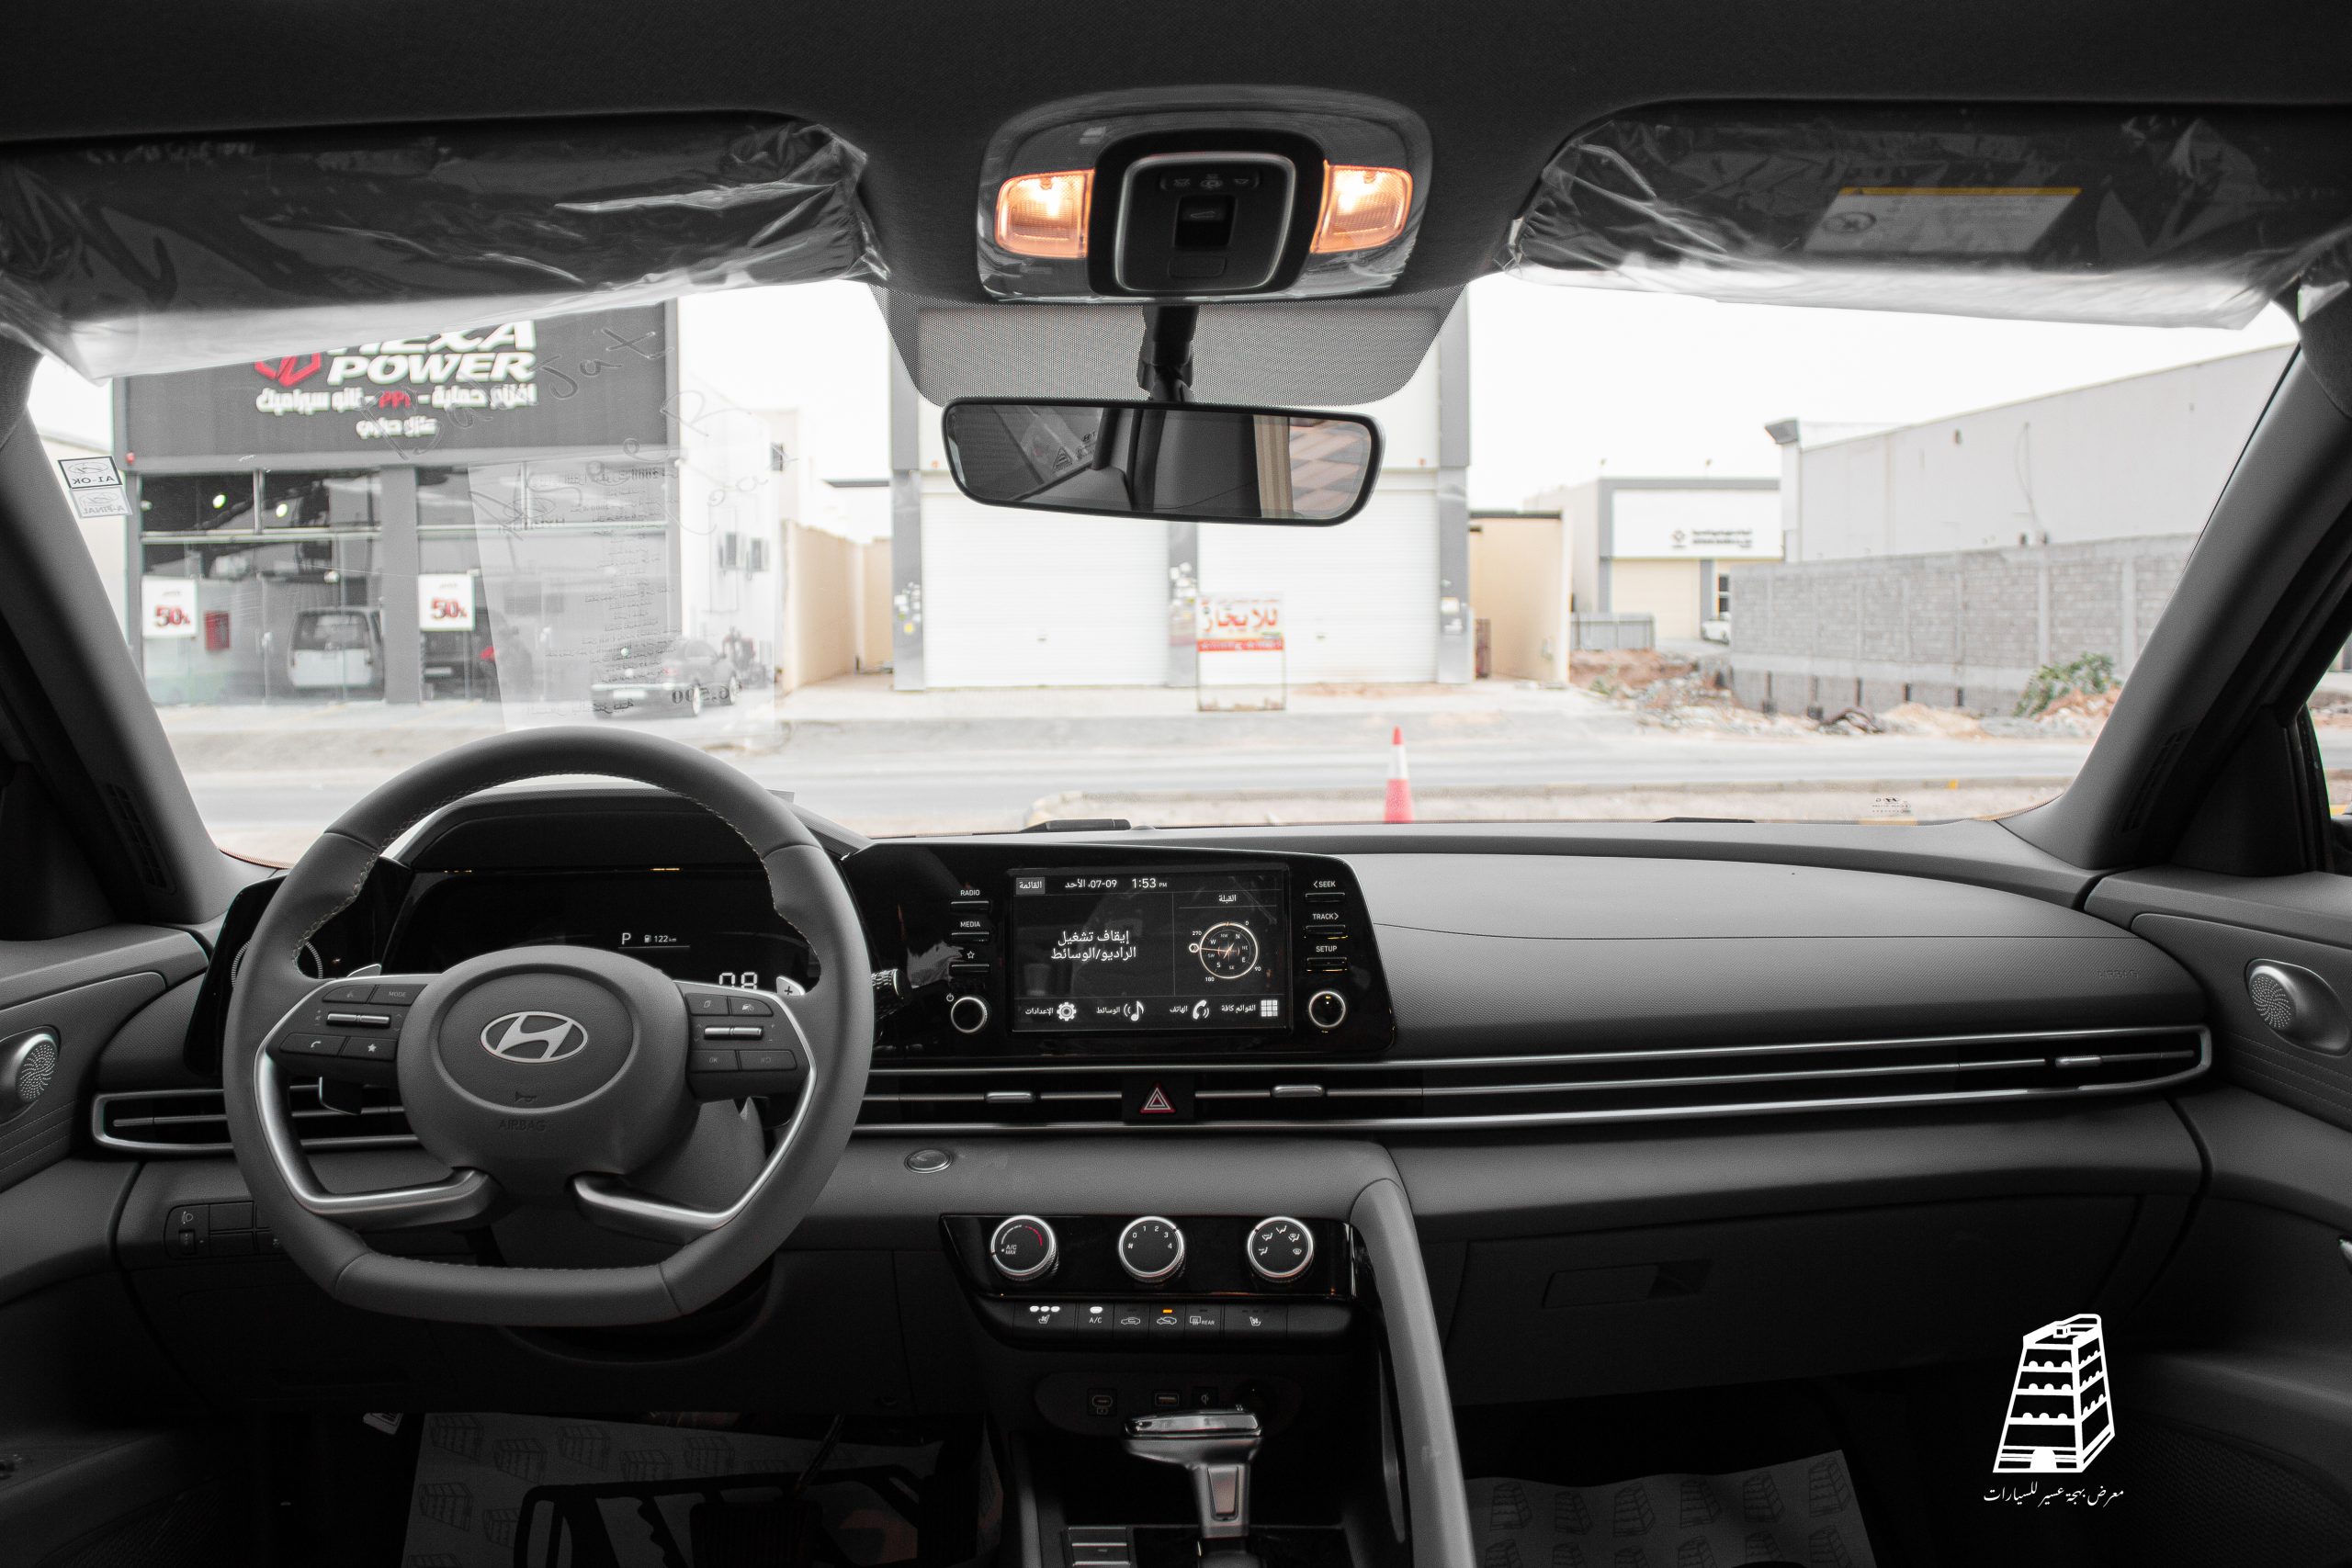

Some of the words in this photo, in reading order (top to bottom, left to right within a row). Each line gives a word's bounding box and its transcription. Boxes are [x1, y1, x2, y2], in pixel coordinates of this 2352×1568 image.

[326, 320, 537, 355] EXA
[326, 352, 537, 386] POWER
[1019, 880, 1044, 890] القائمة
[1131, 878, 1157, 889] 1:53
[1218, 894, 1237, 904] القبلة
[621, 932, 632, 945] P
[1057, 931, 1094, 946] تشغيل
[1097, 929, 1130, 944] إيقاف
